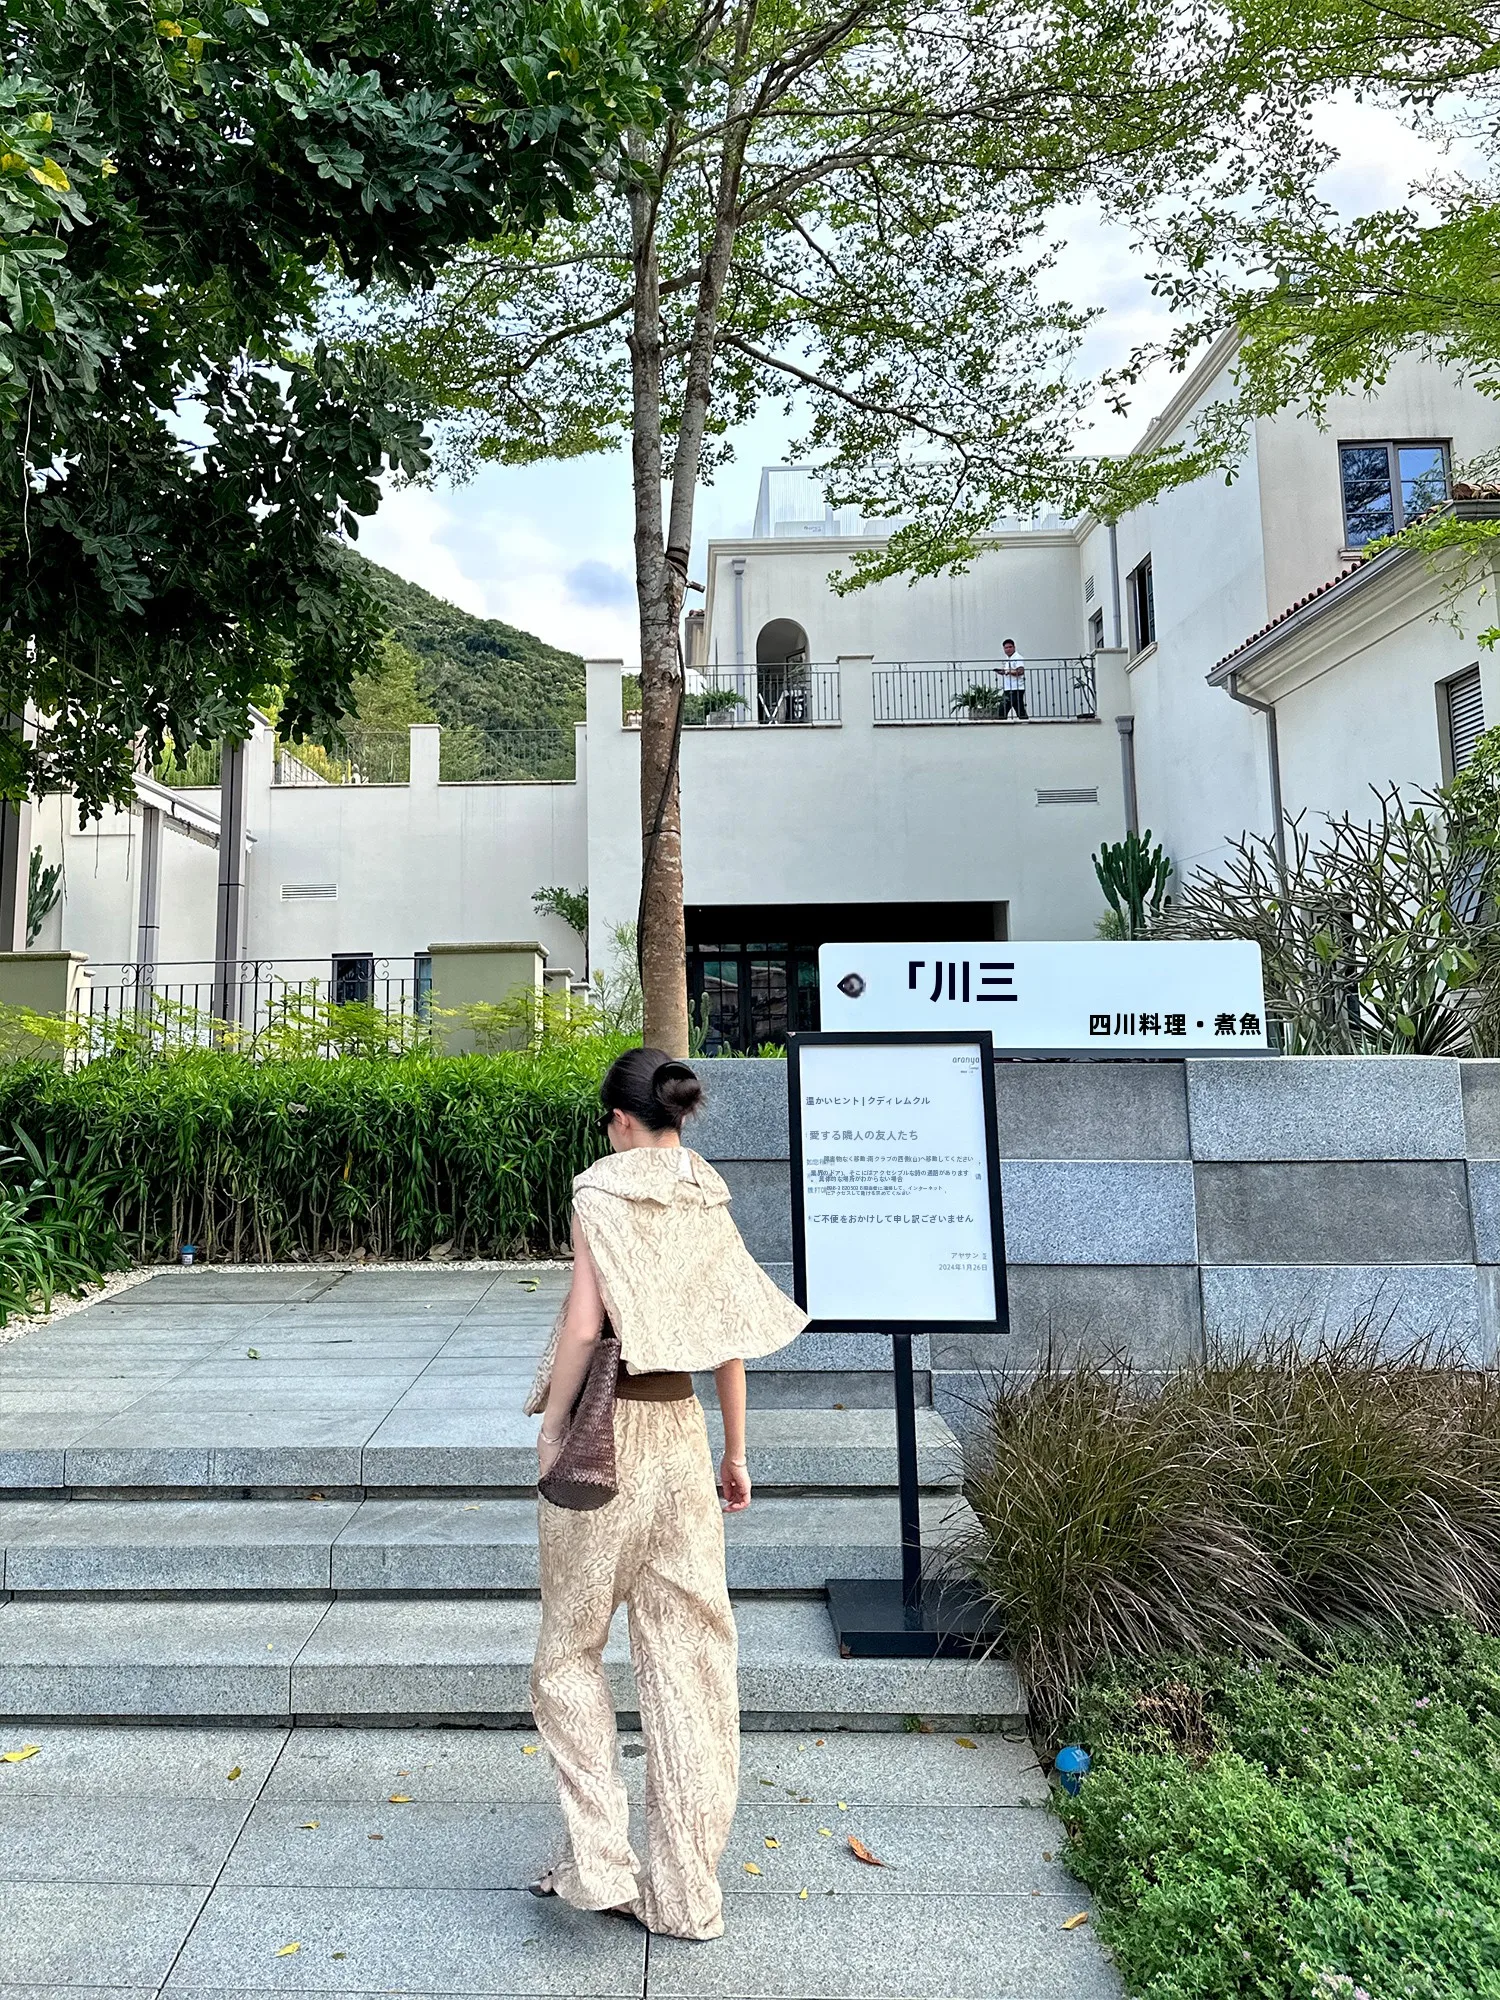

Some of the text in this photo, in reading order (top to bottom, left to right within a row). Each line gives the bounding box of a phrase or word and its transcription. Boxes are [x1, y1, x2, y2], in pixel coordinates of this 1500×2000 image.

[1089, 1012, 1262, 1037] 四川料理・煮魚
[952, 1056, 980, 1066] aranya
[809, 1130, 919, 1141] 愛する隣人の友人たち
[813, 1214, 974, 1224] ご不便をおかけして申し訳ございません
